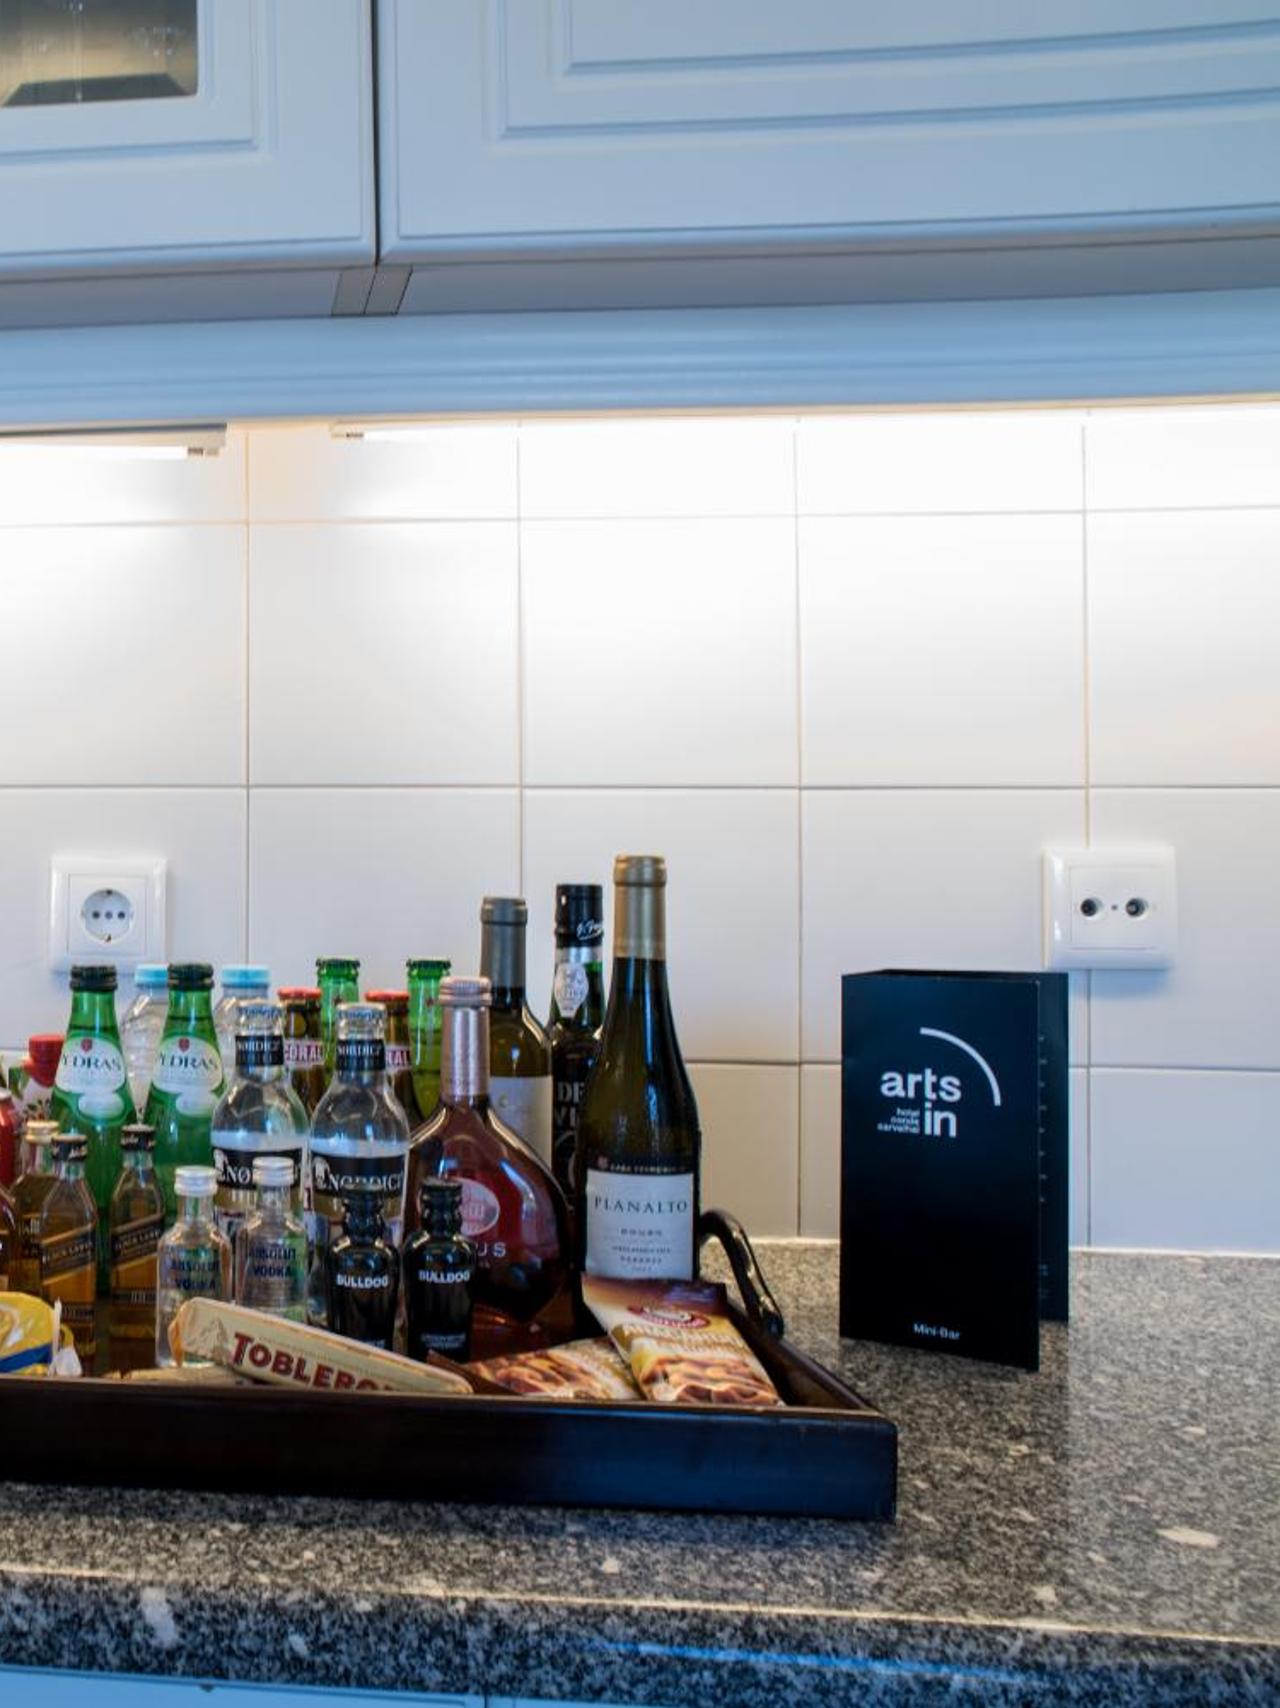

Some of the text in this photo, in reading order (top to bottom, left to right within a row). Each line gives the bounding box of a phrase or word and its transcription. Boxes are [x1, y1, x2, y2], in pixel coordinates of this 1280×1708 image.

[880, 1068, 962, 1102] arts
[924, 1101, 957, 1138] in
[594, 1195, 688, 1214] PLANALTO
[336, 1273, 389, 1289] BULLDOG
[418, 1269, 471, 1284] BULLDOG
[230, 1331, 399, 1390] TOBLER
